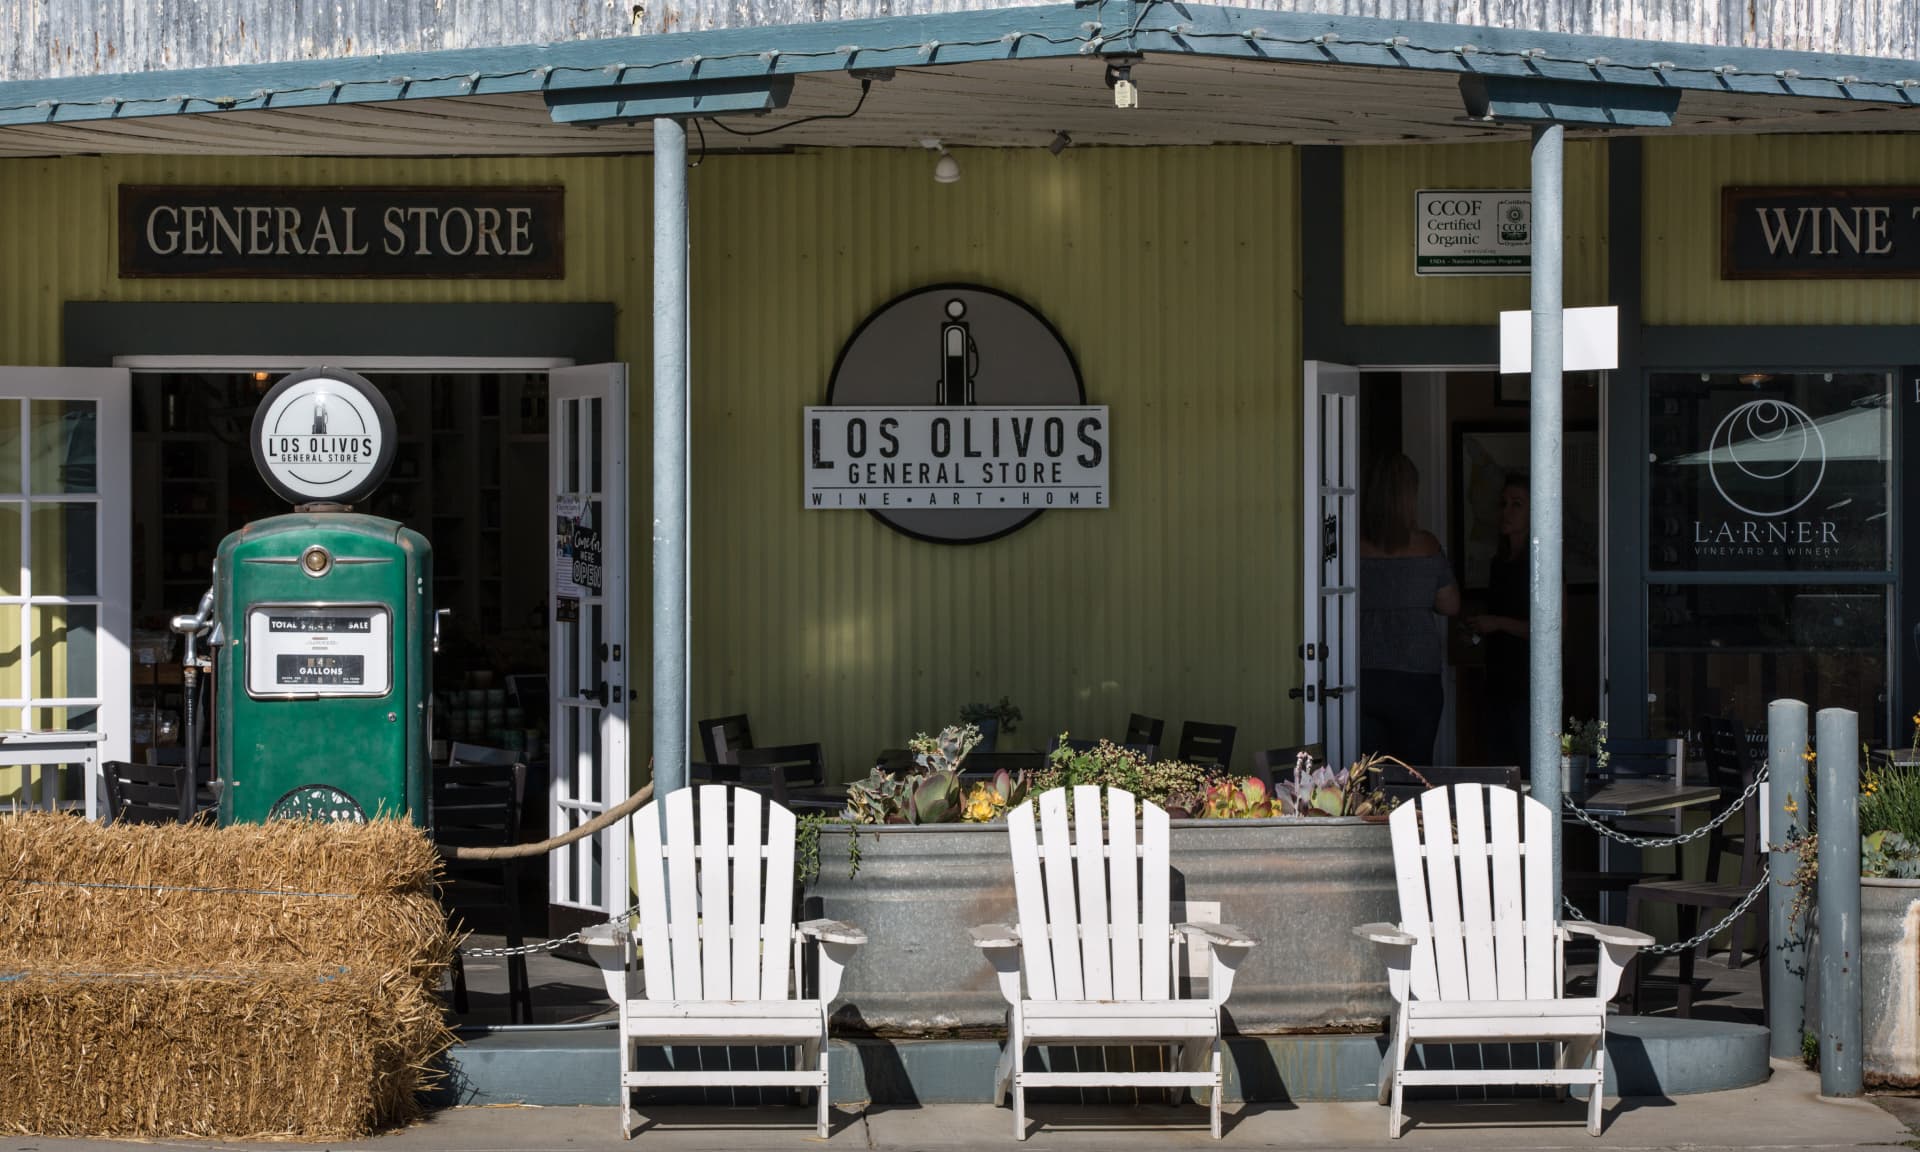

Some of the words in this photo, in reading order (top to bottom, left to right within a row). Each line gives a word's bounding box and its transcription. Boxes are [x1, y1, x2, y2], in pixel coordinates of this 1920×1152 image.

[1427, 199, 1482, 216] CCOF
[146, 205, 369, 256] GENERAL
[383, 206, 534, 256] STORE
[1427, 218, 1481, 231] Certified
[1502, 223, 1527, 231] CCOF
[1755, 206, 1893, 255] WINE
[1427, 232, 1480, 248] Organic
[269, 437, 300, 457] LOS
[310, 437, 372, 457] OLIVOS
[811, 417, 900, 469] LOS
[930, 416, 1103, 469] OLIVOS
[281, 454, 322, 462] GENERAL
[328, 454, 358, 462] STORE
[848, 462, 965, 484] GENERAL
[982, 462, 1062, 484] STORE
[811, 492, 890, 505] WINE
[929, 492, 984, 505] ART
[1022, 491, 1103, 505] HOME
[1694, 546, 1765, 556] VINEYARD
[1787, 546, 1840, 556] WINERY
[573, 560, 602, 588] OPEN
[271, 621, 298, 629] TOTAL
[348, 621, 369, 629] SALE
[299, 667, 343, 676] GALLONS
